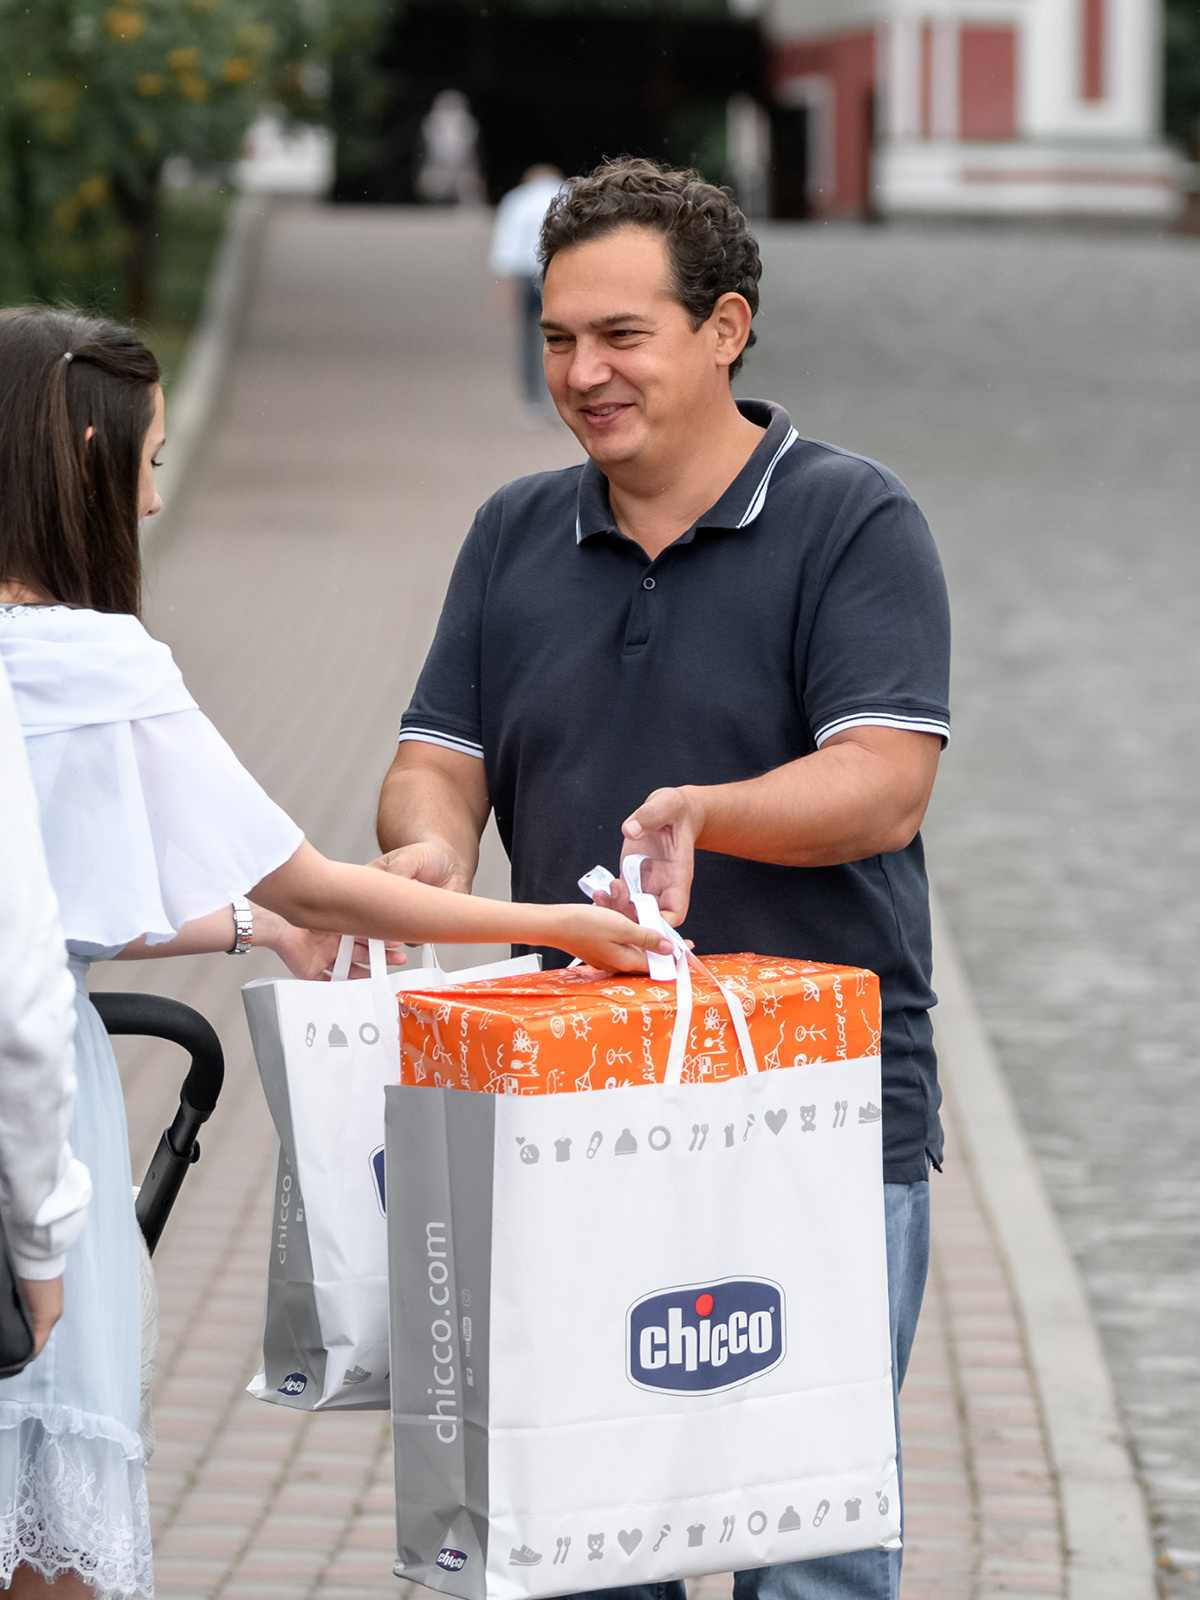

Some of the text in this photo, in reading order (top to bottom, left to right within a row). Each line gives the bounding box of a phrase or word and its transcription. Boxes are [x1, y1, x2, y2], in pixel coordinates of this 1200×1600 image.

[459, 1007, 475, 1091] hicco.com
[426, 1222, 457, 1443] chicco.com
[640, 1294, 773, 1371] chicco
